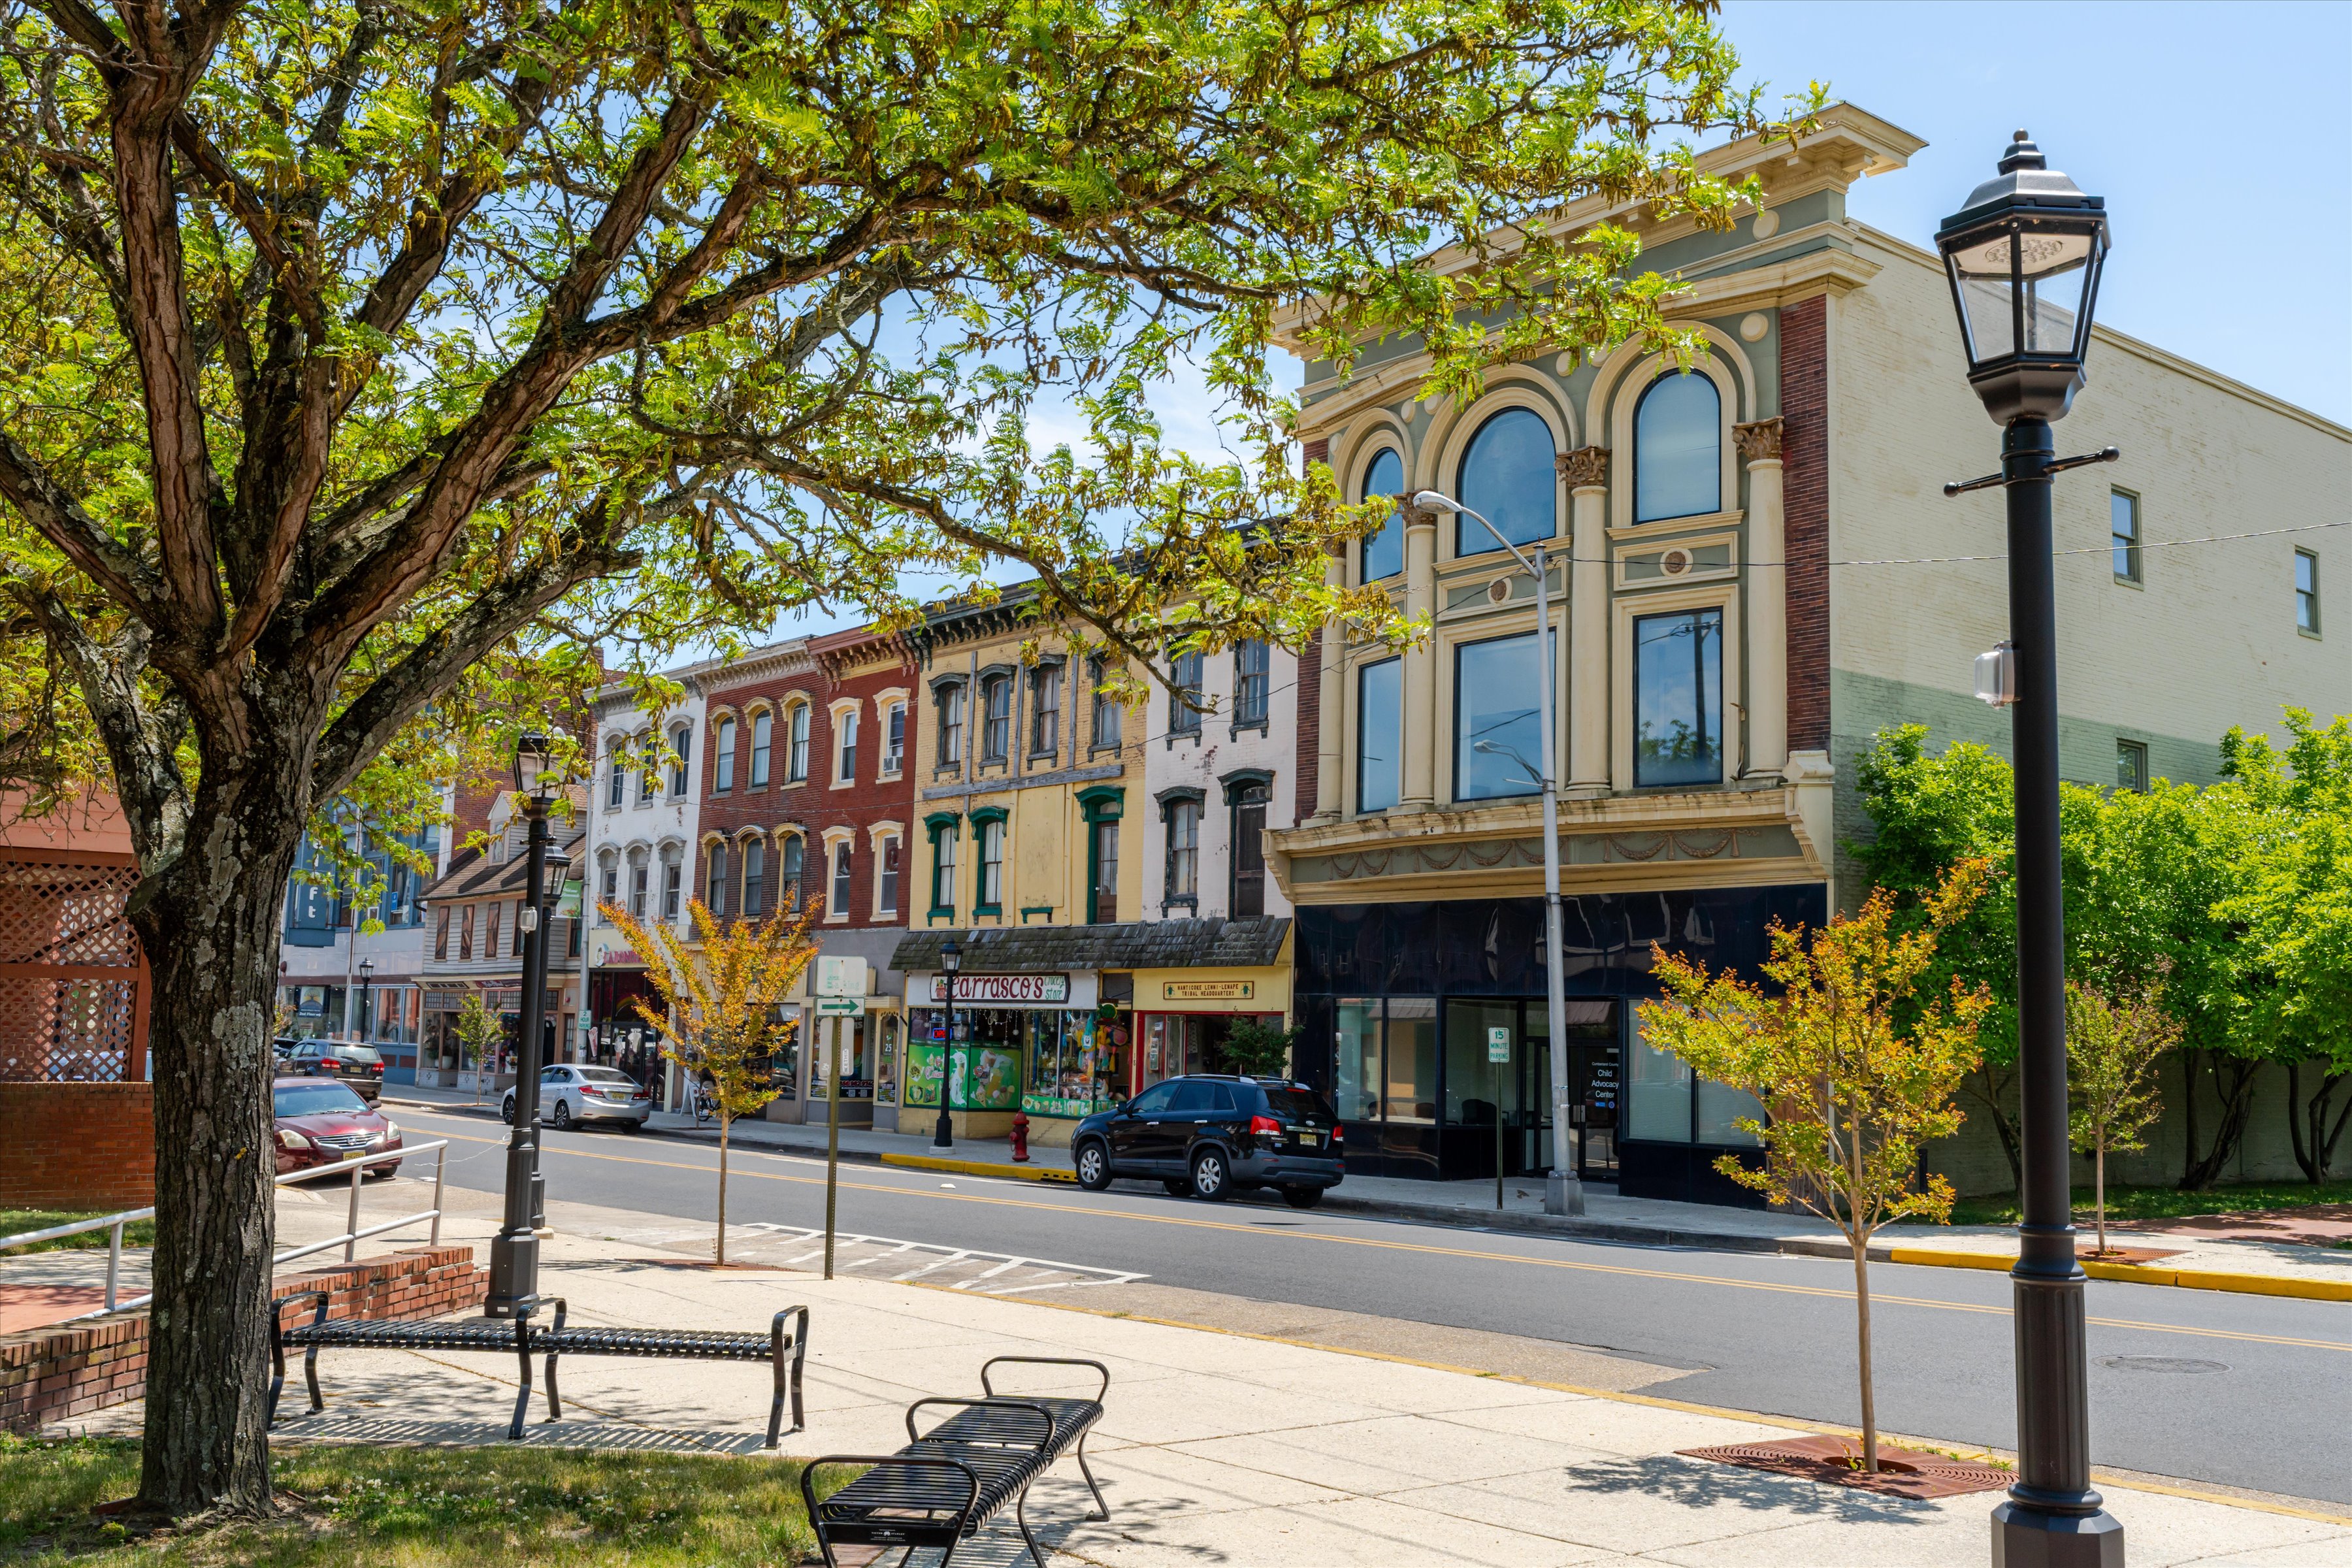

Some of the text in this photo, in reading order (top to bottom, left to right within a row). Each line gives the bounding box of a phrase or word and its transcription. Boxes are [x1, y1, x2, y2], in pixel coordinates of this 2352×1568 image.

[934, 1029, 946, 1039] OPE
[1495, 1031, 1504, 1039] 15
[885, 1043, 892, 1053] 25
[1592, 1080, 1619, 1090] Advocacy
[1595, 1090, 1614, 1098] Center
